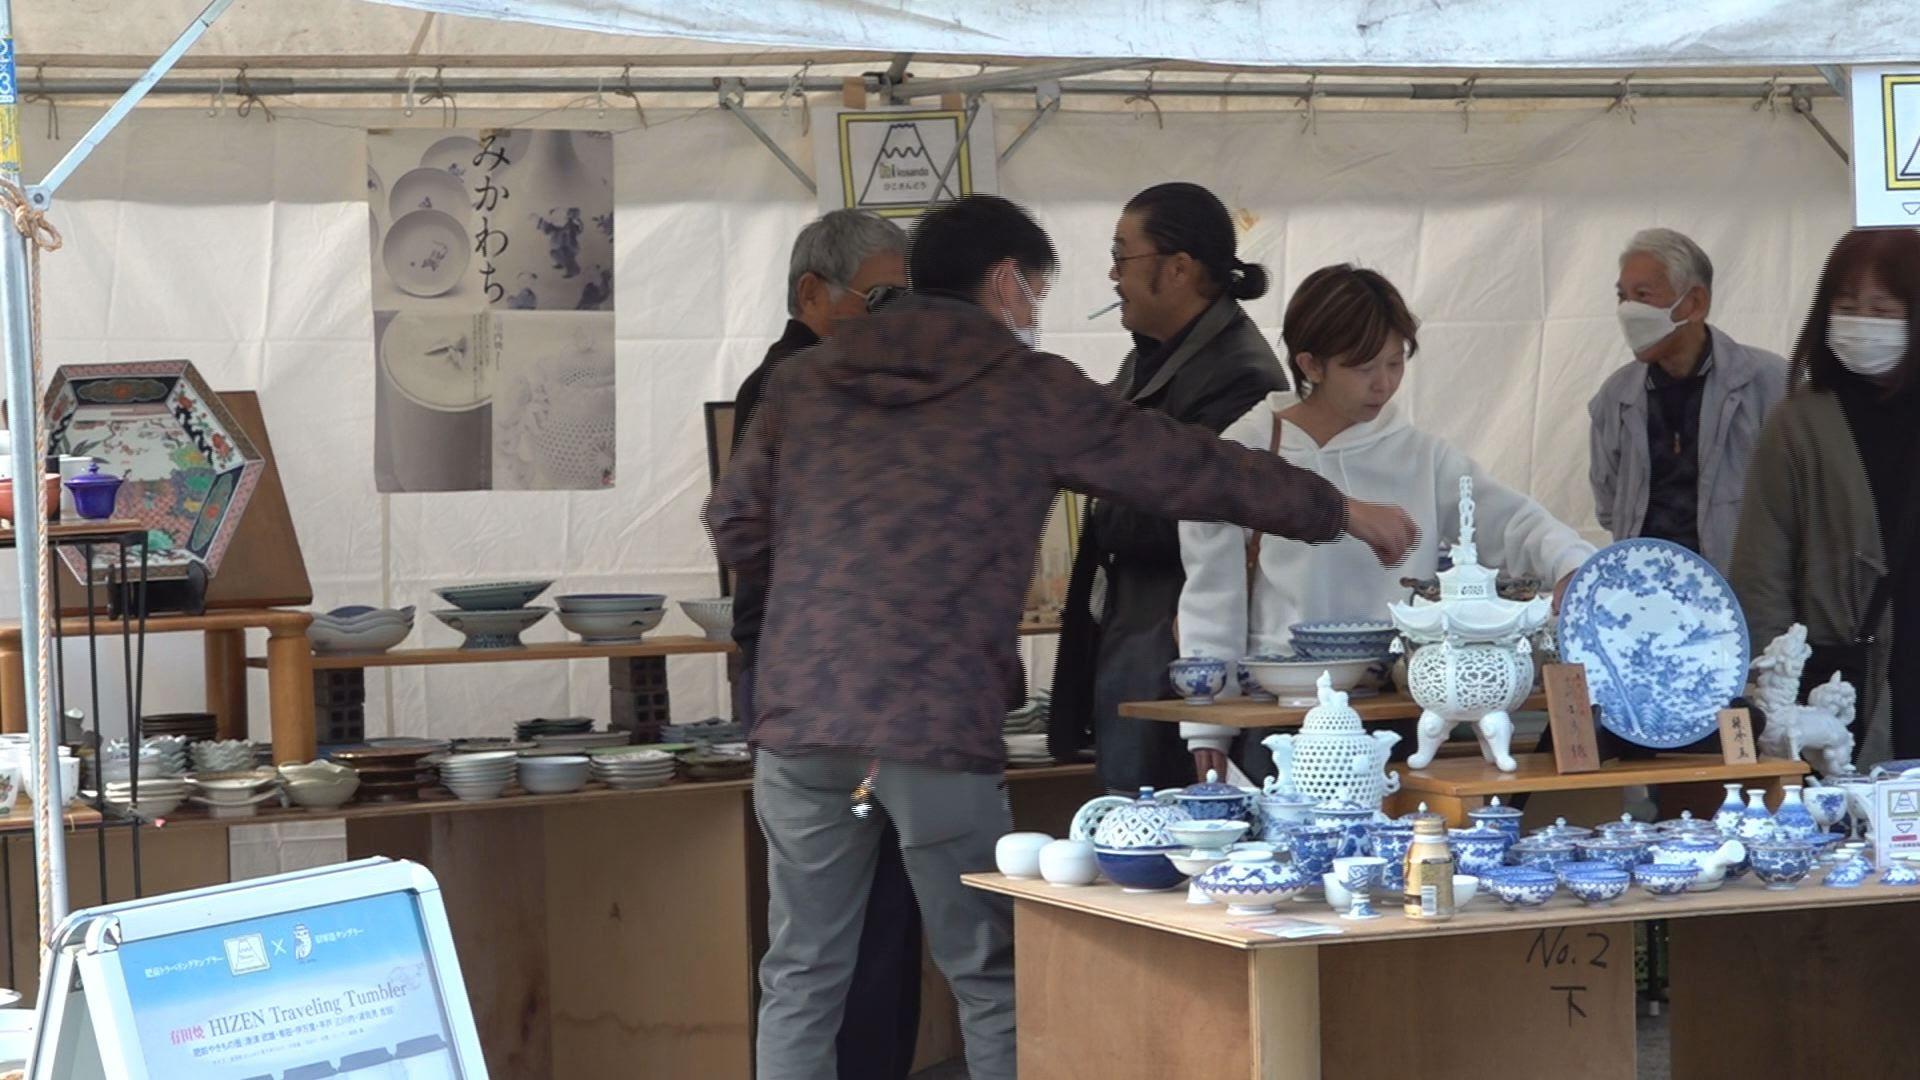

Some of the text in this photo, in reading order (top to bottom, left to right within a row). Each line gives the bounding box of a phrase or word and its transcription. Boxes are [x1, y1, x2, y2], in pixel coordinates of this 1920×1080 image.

[472, 134, 511, 304] みかわち
[1526, 926, 1610, 969] No. 2
[207, 1007, 266, 1038] HIZEN
[268, 997, 343, 1024] Traveling
[343, 981, 408, 1008] Tumbler
[1550, 985, 1587, 1028] 下
